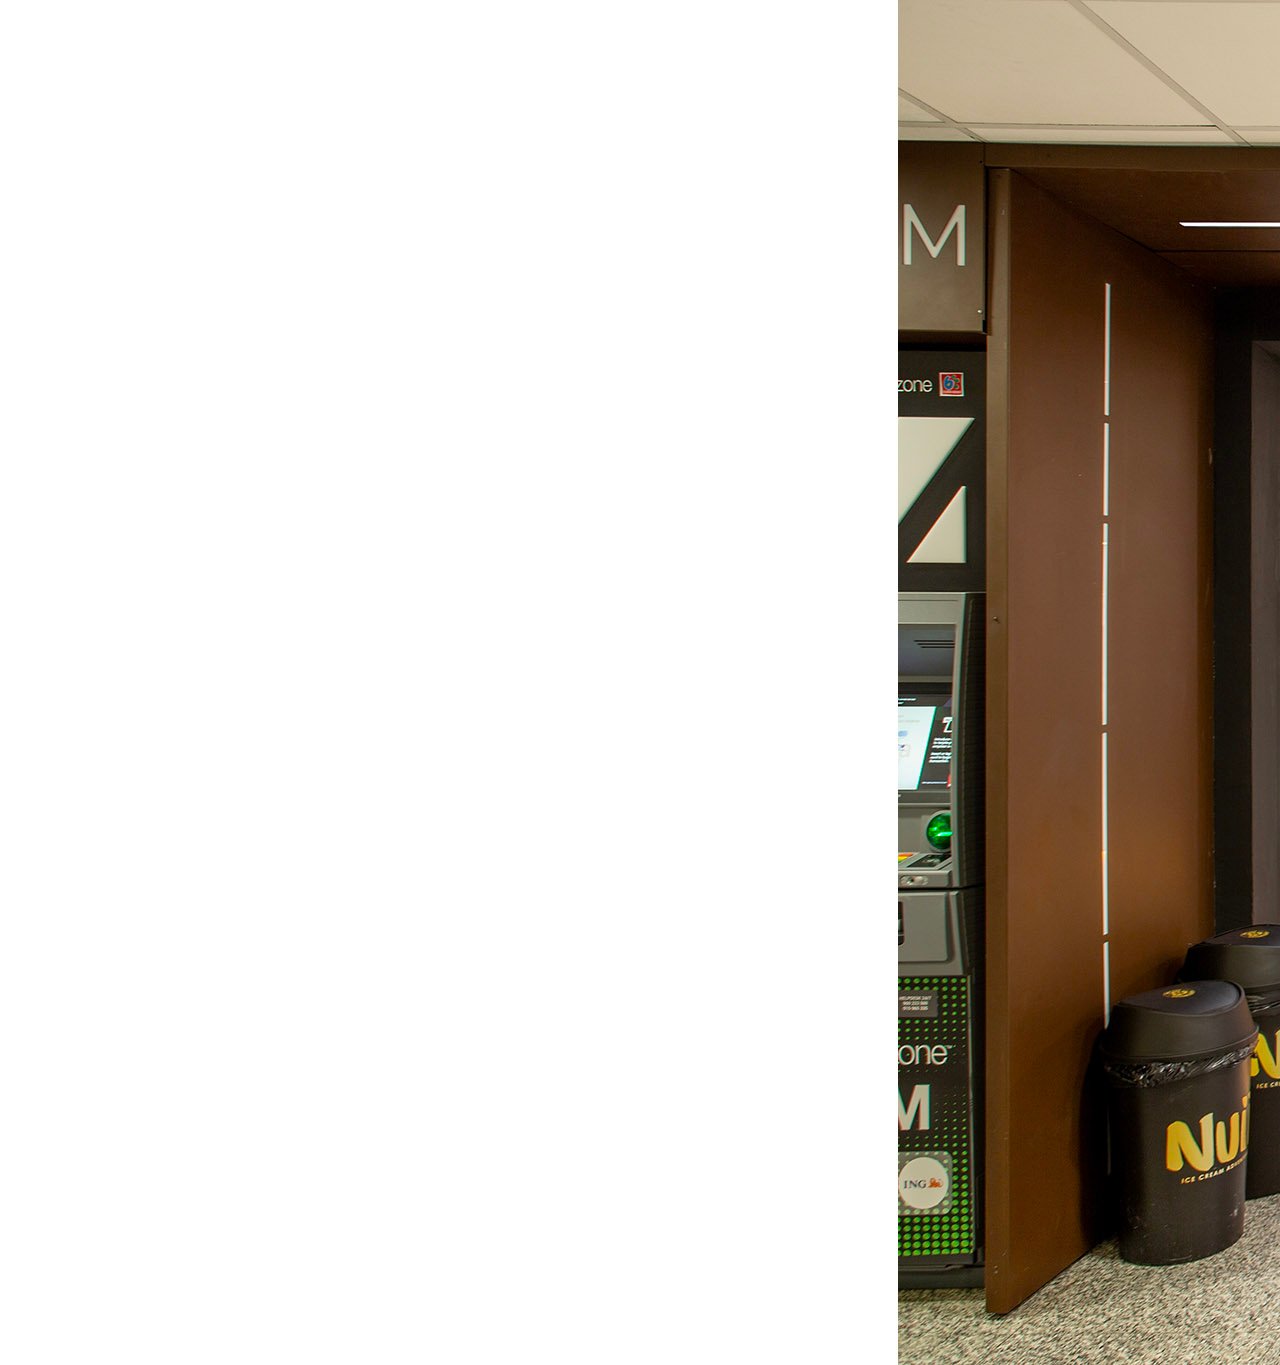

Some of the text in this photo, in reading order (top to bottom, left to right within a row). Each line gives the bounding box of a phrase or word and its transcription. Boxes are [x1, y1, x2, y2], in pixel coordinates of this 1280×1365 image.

[903, 203, 966, 266] M
[898, 1044, 948, 1065] one
[903, 1180, 927, 1188] ING
[1180, 1176, 1196, 1184] ICE
[1198, 1168, 1225, 1180] CREAM
